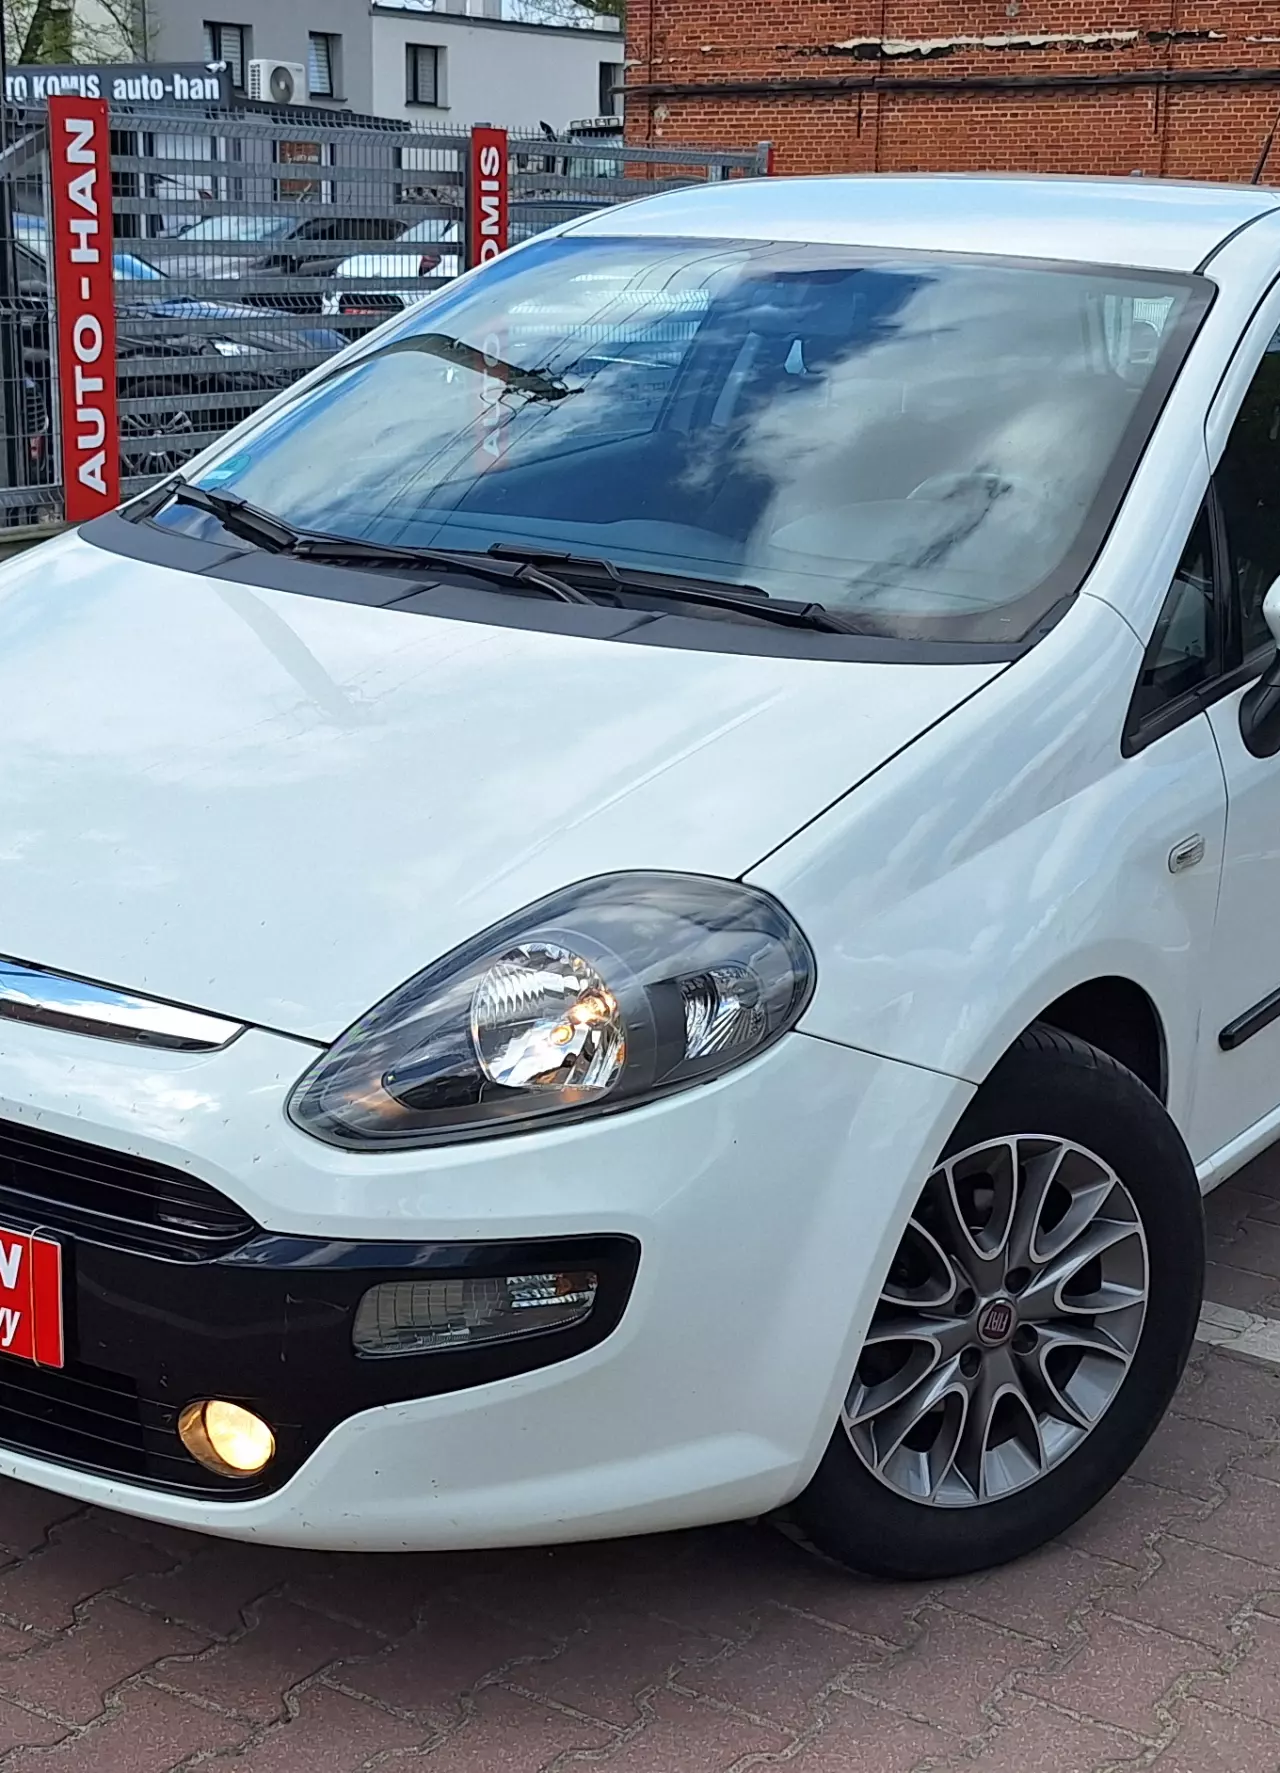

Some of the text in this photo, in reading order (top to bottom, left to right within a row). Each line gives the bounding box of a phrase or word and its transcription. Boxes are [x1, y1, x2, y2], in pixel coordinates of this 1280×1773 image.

[6, 76, 27, 100] TO
[113, 74, 219, 100] auto-han
[481, 146, 499, 265] OMIS
[985, 1310, 1009, 1332] FIAT
